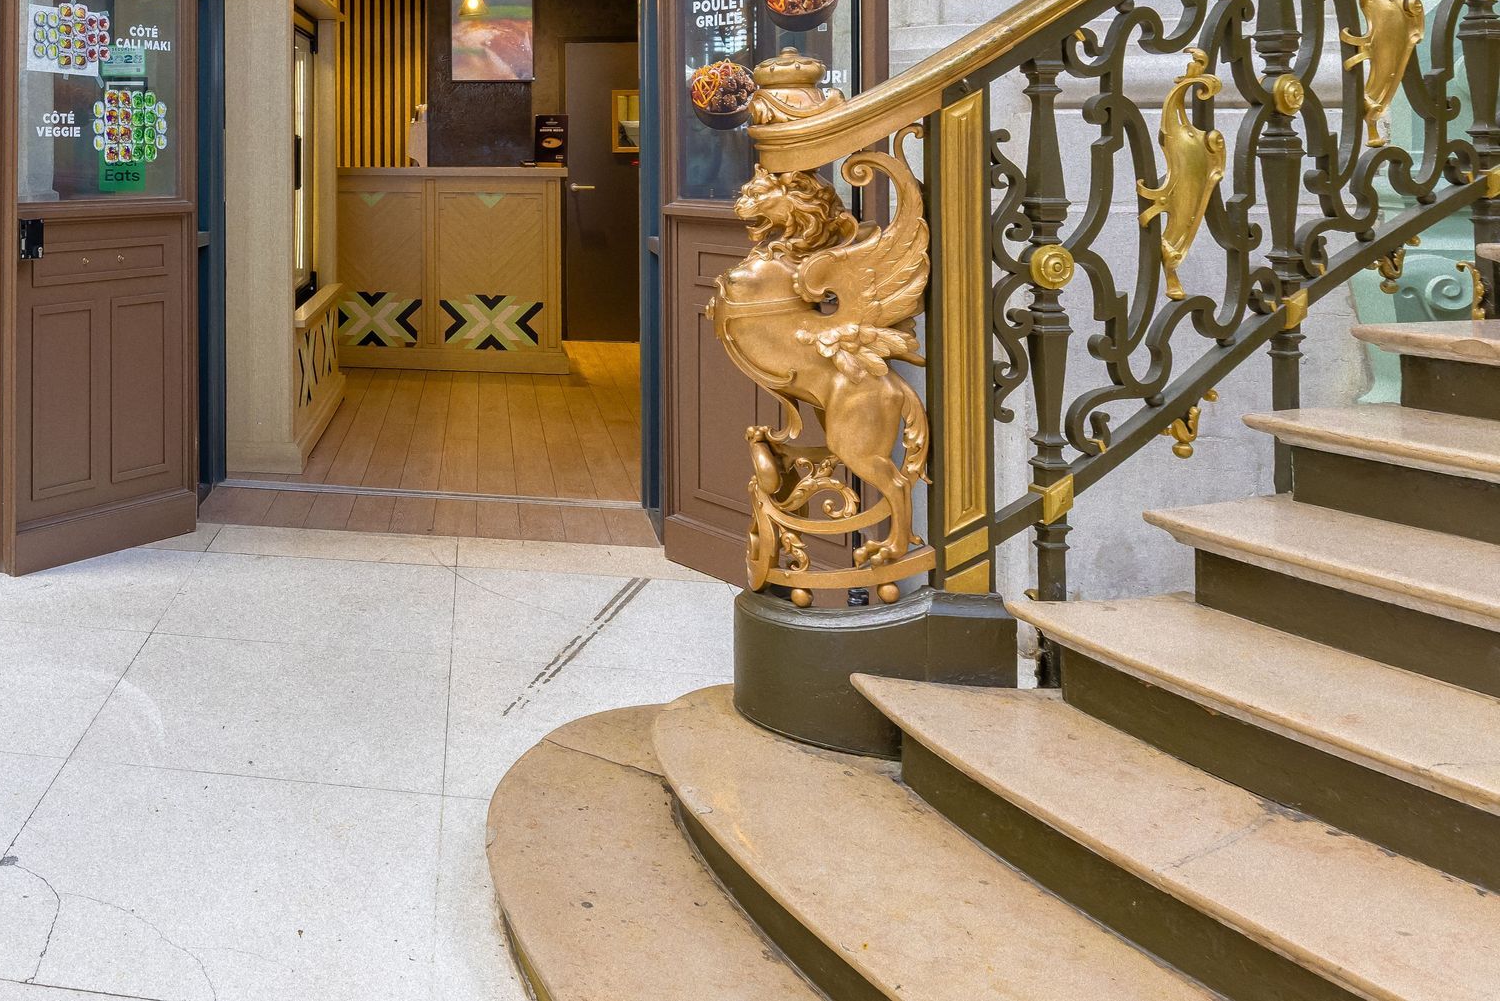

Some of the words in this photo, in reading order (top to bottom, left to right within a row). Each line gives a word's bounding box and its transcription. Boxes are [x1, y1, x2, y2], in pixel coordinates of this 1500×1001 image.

[695, 9, 743, 29] GRILLÉ
[129, 24, 159, 38] CÔTÉ
[116, 37, 141, 49] CALI
[144, 39, 171, 52] MAKI
[42, 111, 75, 124] CÔTÉ
[36, 124, 81, 138] VEGGIE
[105, 168, 140, 182] Eats
